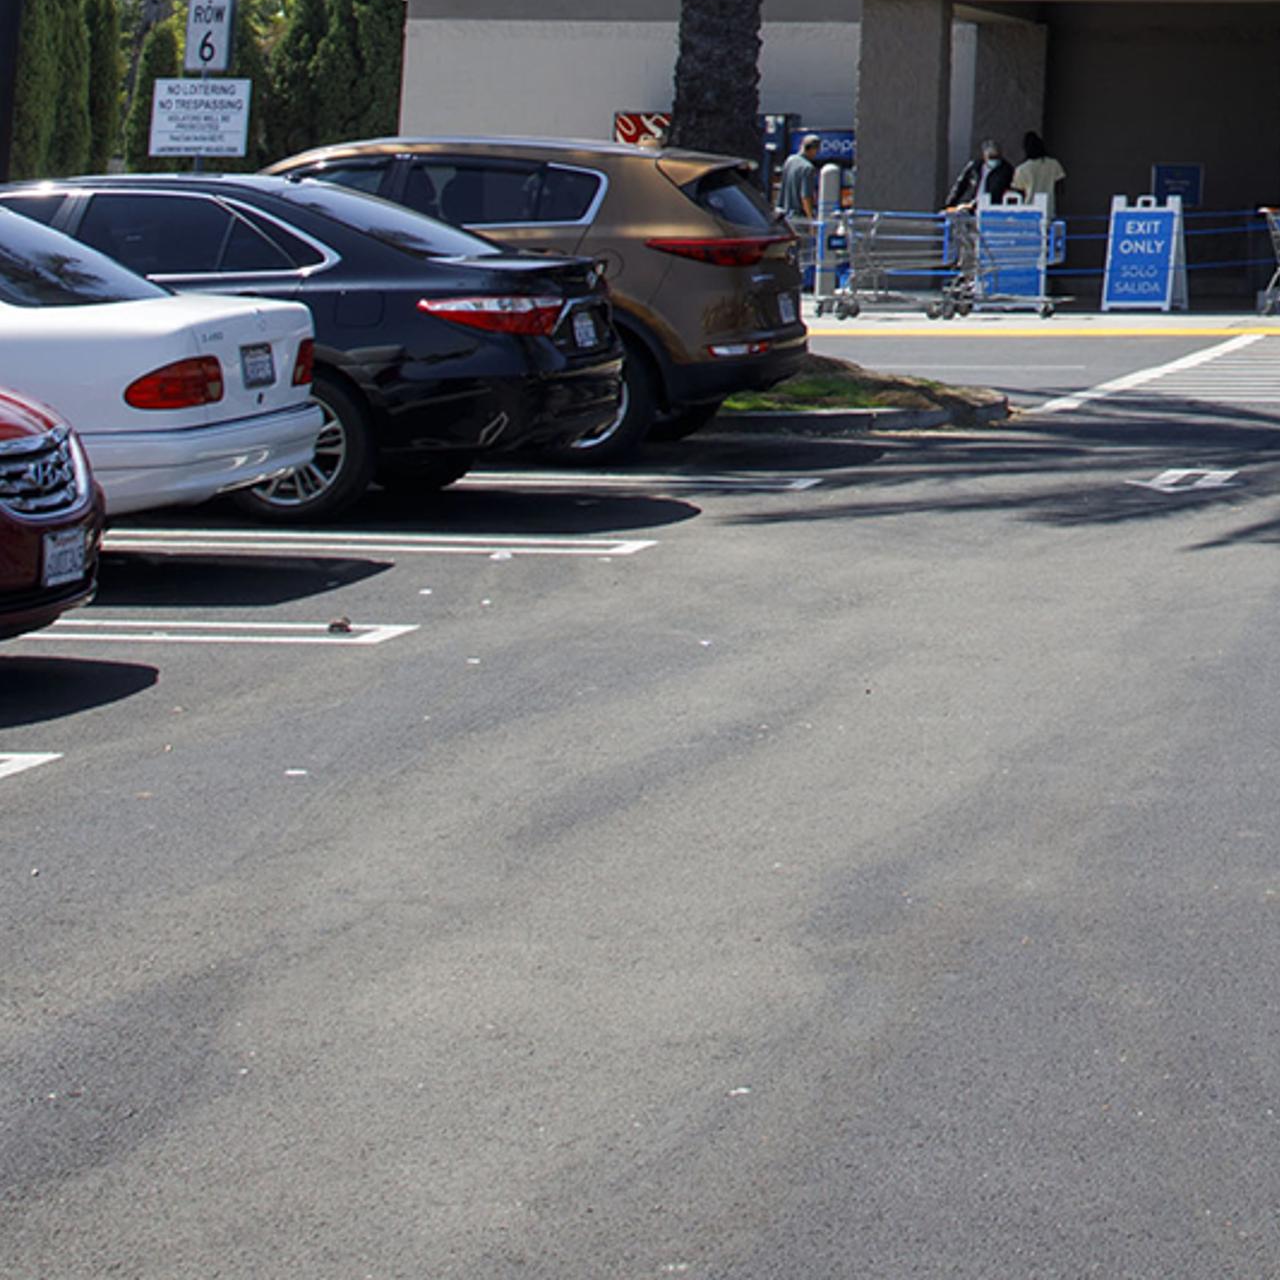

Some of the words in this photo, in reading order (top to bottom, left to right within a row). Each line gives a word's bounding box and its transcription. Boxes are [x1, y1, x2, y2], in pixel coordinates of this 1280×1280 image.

[193, 5, 227, 23] ROW
[198, 30, 215, 62] 6
[167, 84, 181, 95] NO
[159, 99, 173, 110] NO
[175, 99, 244, 111] TRESPASSING
[1125, 220, 1162, 235] EXIT
[1119, 239, 1166, 255] ONLY
[1119, 264, 1158, 278] SOLO
[1114, 280, 1161, 295] SALIDA
